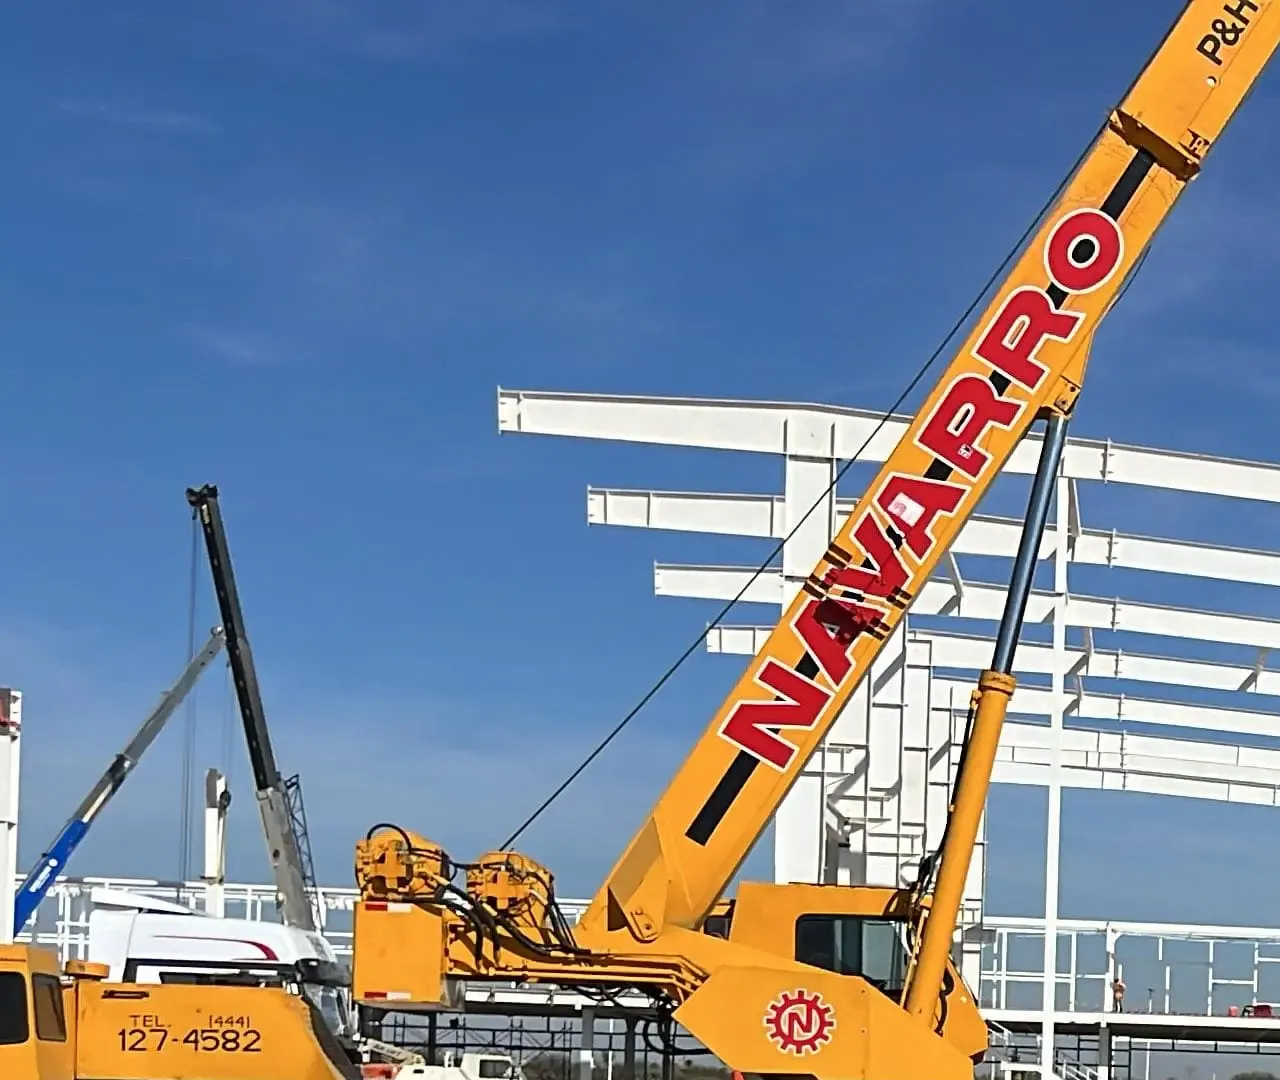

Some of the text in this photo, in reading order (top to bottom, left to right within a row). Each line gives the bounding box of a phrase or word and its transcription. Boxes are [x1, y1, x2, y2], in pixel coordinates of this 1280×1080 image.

[1196, 0, 1259, 66] P&H
[718, 208, 1123, 770] NAVARRO
[117, 1028, 262, 1052] 127-4582
[128, 1014, 172, 1028] TEL.
